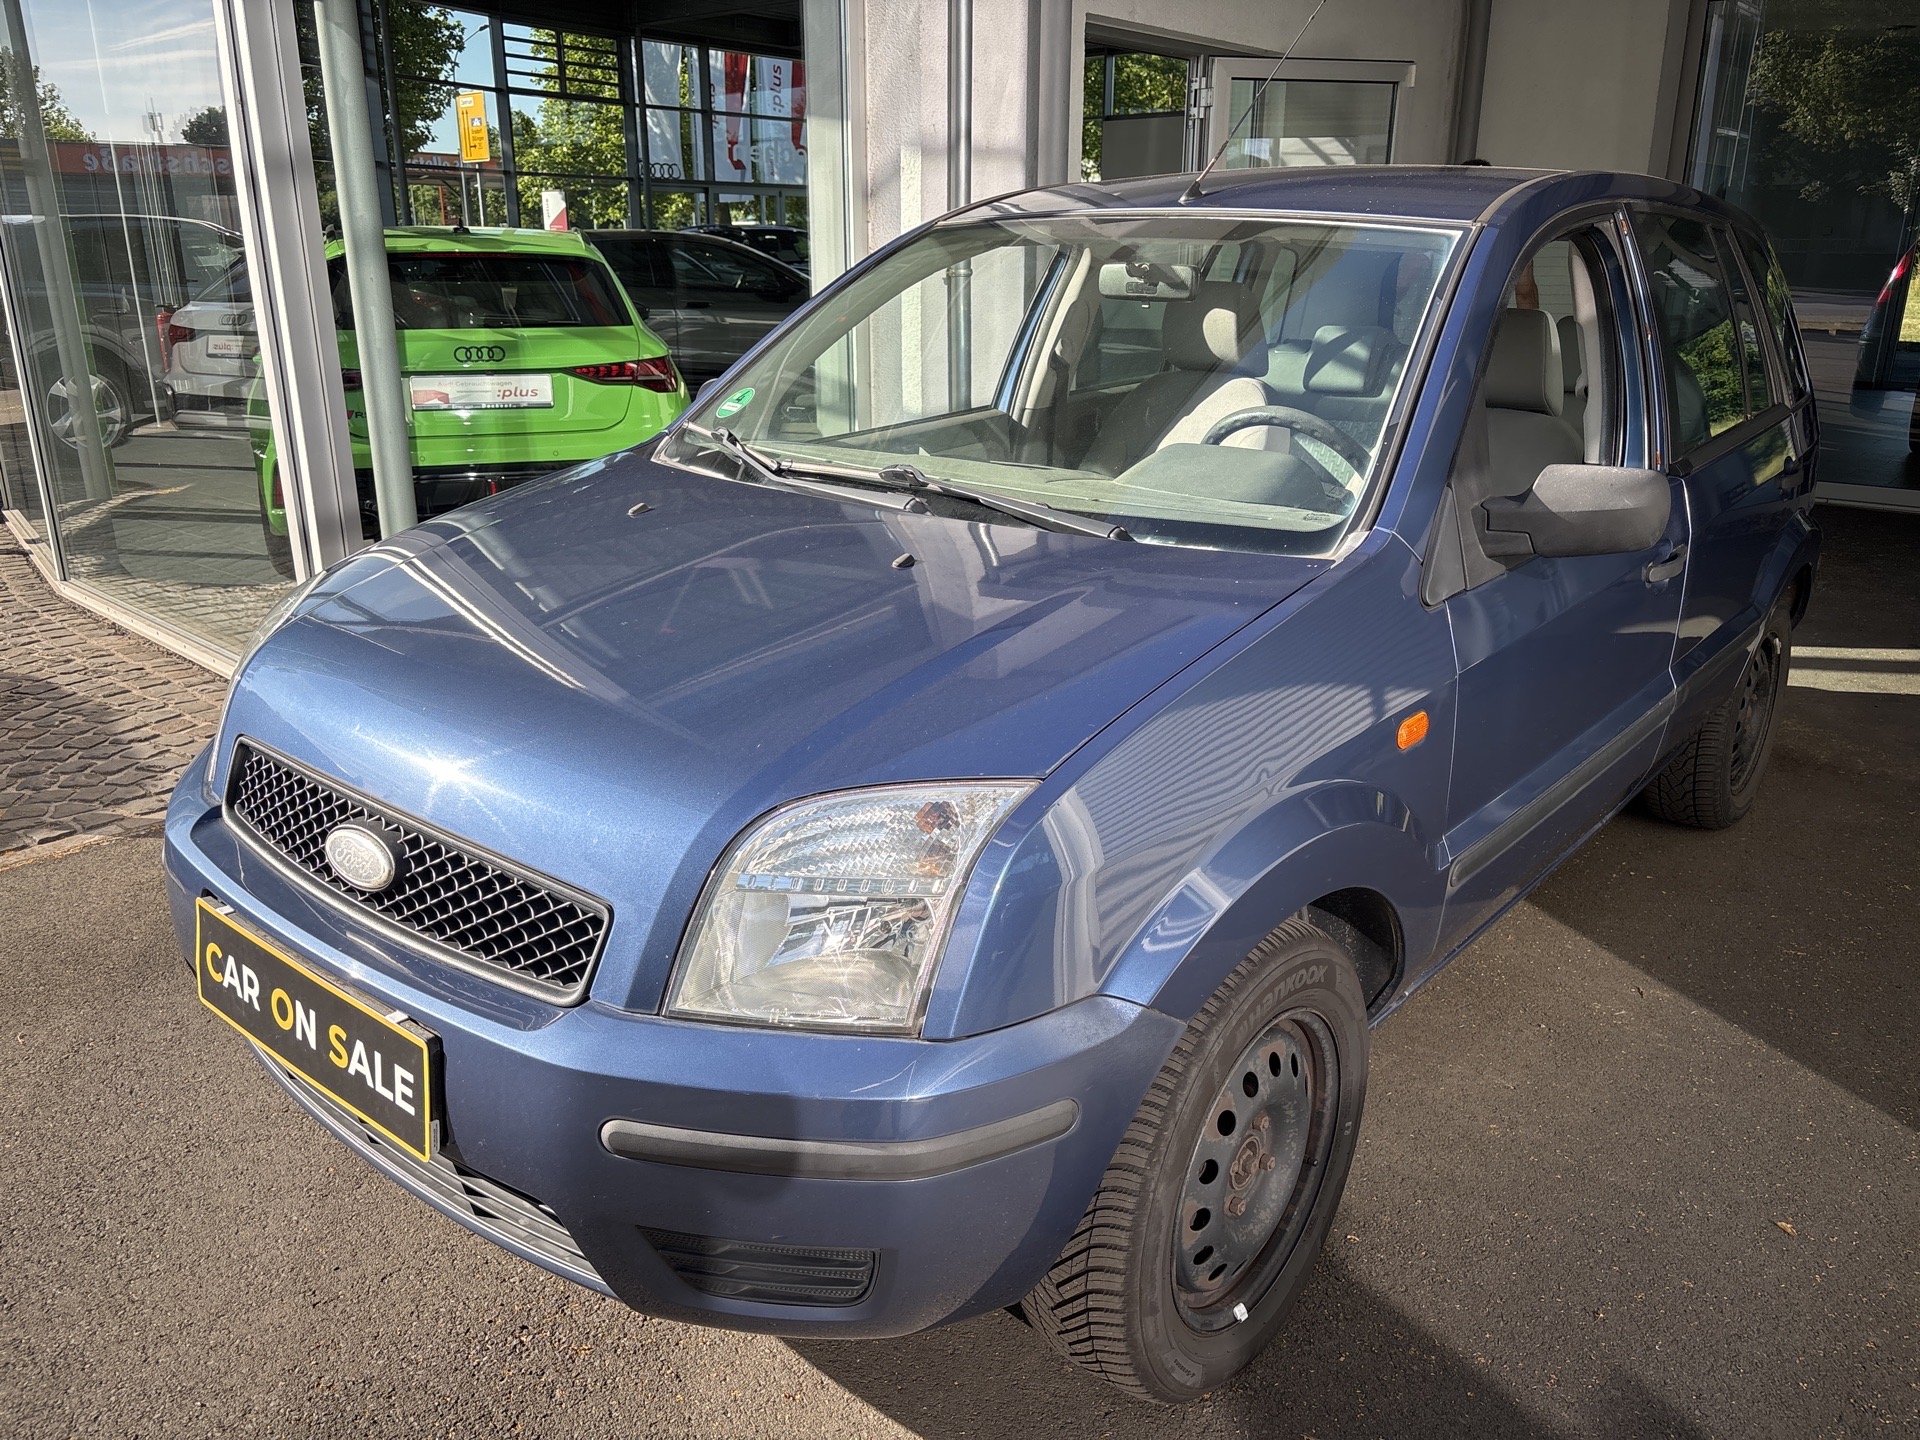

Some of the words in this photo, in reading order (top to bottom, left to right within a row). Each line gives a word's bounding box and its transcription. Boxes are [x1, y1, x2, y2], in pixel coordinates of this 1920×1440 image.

[497, 386, 539, 399] :plus
[735, 390, 750, 403] 4
[205, 942, 261, 1012] CAR
[271, 987, 317, 1050] ON
[328, 1024, 415, 1116] SALE
